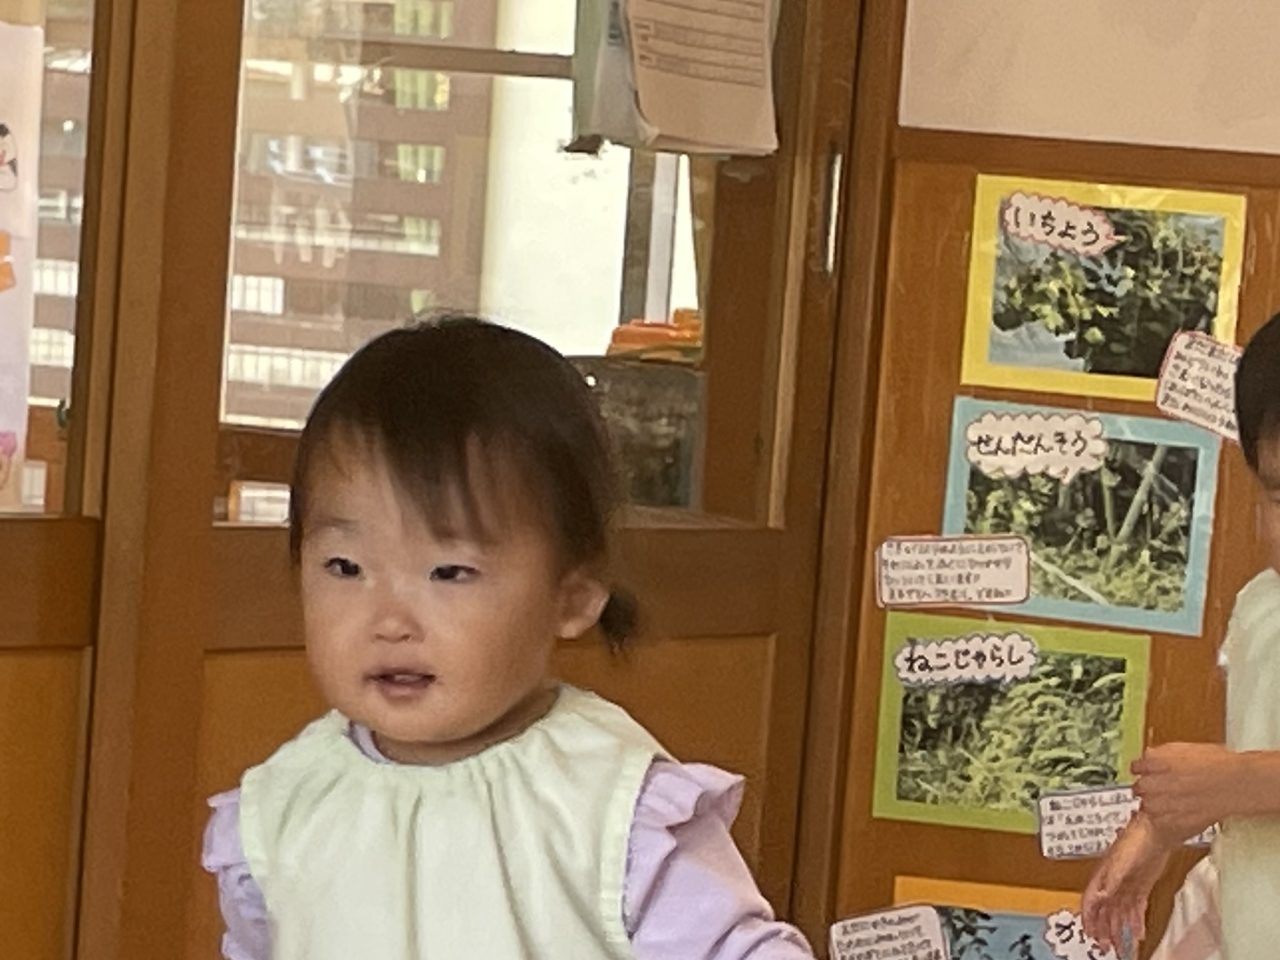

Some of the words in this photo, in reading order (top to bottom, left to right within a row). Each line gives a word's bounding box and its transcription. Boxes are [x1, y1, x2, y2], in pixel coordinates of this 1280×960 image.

[904, 637, 1025, 674] ねこじゃらし
